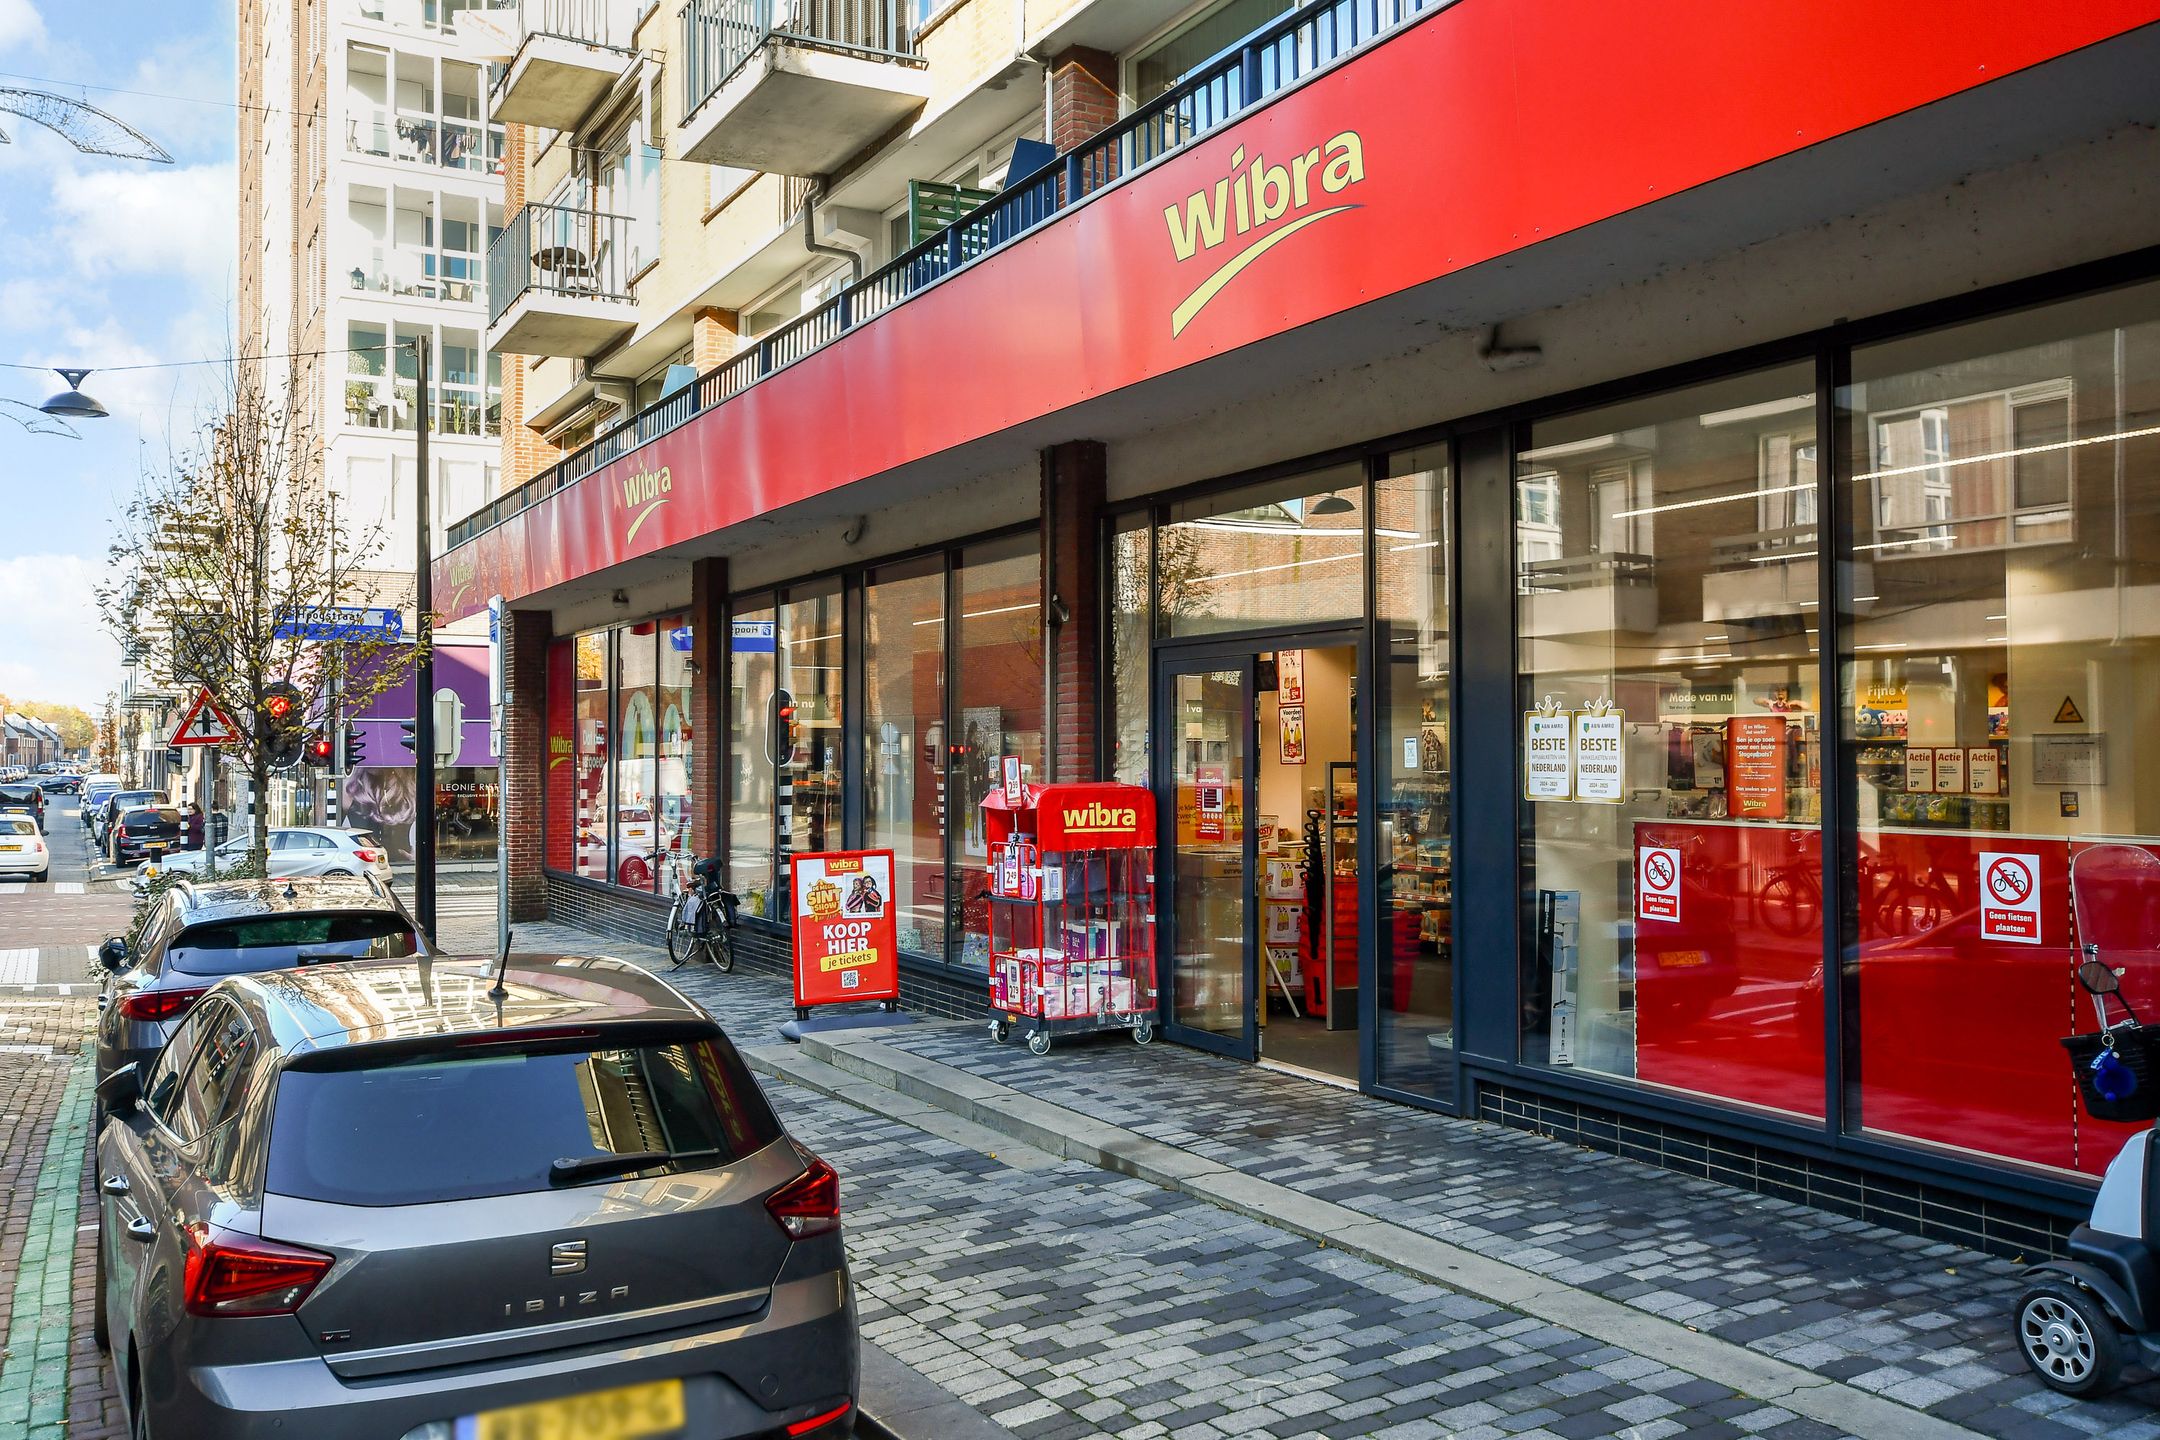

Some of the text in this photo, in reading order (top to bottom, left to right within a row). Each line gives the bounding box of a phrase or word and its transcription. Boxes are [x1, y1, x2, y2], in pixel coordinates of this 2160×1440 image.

[1669, 691, 1733, 702] Mode van nu
[1532, 738, 1565, 751] BESTE
[1580, 738, 1616, 751] BESTE
[1909, 753, 1930, 761] Actie
[1938, 752, 1961, 761] Actie
[1971, 752, 1996, 762] Actie
[1532, 763, 1566, 772] NEDERLAND
[1580, 764, 1617, 773] NEDERLAND
[441, 783, 475, 791] LEONIE
[1743, 799, 1766, 807] Wibra
[1063, 802, 1136, 827] wibra
[830, 859, 859, 869] wibra
[807, 888, 842, 906] SINT
[1658, 896, 1674, 904] fietsen
[814, 901, 837, 911] SHOW
[1650, 905, 1670, 913] plaatsen
[1989, 911, 2032, 922] Geen fietsen
[823, 922, 872, 940] KOOP
[1995, 923, 2026, 933] plaatsen
[828, 938, 869, 955] HIER
[828, 953, 872, 969] je tickets
[505, 1285, 629, 1316] IBIZA
